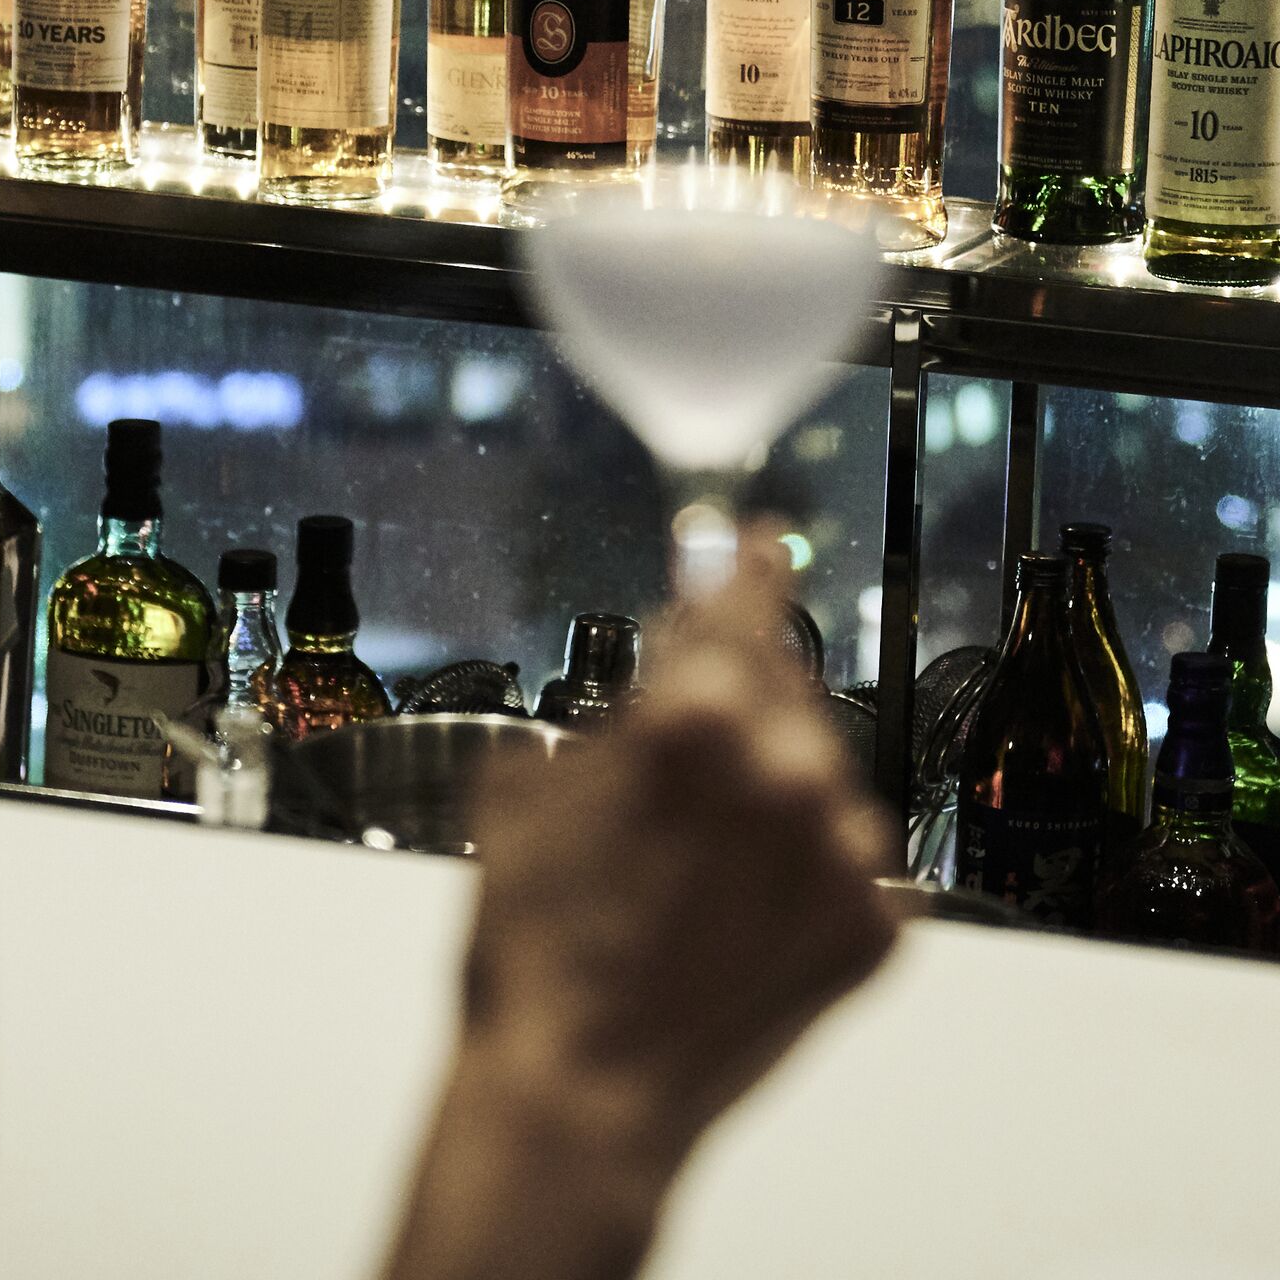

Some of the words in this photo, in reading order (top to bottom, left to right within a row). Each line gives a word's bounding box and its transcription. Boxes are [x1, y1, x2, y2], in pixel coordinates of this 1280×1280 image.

[847, 1, 871, 22] 12
[891, 8, 918, 17] YEARS
[17, 21, 34, 40] 10
[39, 25, 106, 44] YEARS
[823, 50, 849, 61] TWELVE
[852, 54, 879, 64] YEARS
[881, 56, 900, 64] OLD
[740, 63, 760, 84] 10
[1004, 67, 1023, 80] ISLAY
[1026, 72, 1067, 87] SINGLE
[1071, 77, 1105, 88] MALT
[1167, 68, 1189, 80] ISLAY
[1191, 73, 1228, 84] SINGLE
[1231, 76, 1259, 85] MALT
[540, 85, 559, 100] 10
[1007, 81, 1040, 97] SCOTCH
[1044, 88, 1094, 101] WHISKY
[1171, 81, 1205, 93] SCOTCH
[1208, 87, 1250, 96] WHISKY
[1028, 100, 1060, 115] TEN
[1190, 110, 1219, 142] 10
[1189, 167, 1219, 184] 1815
